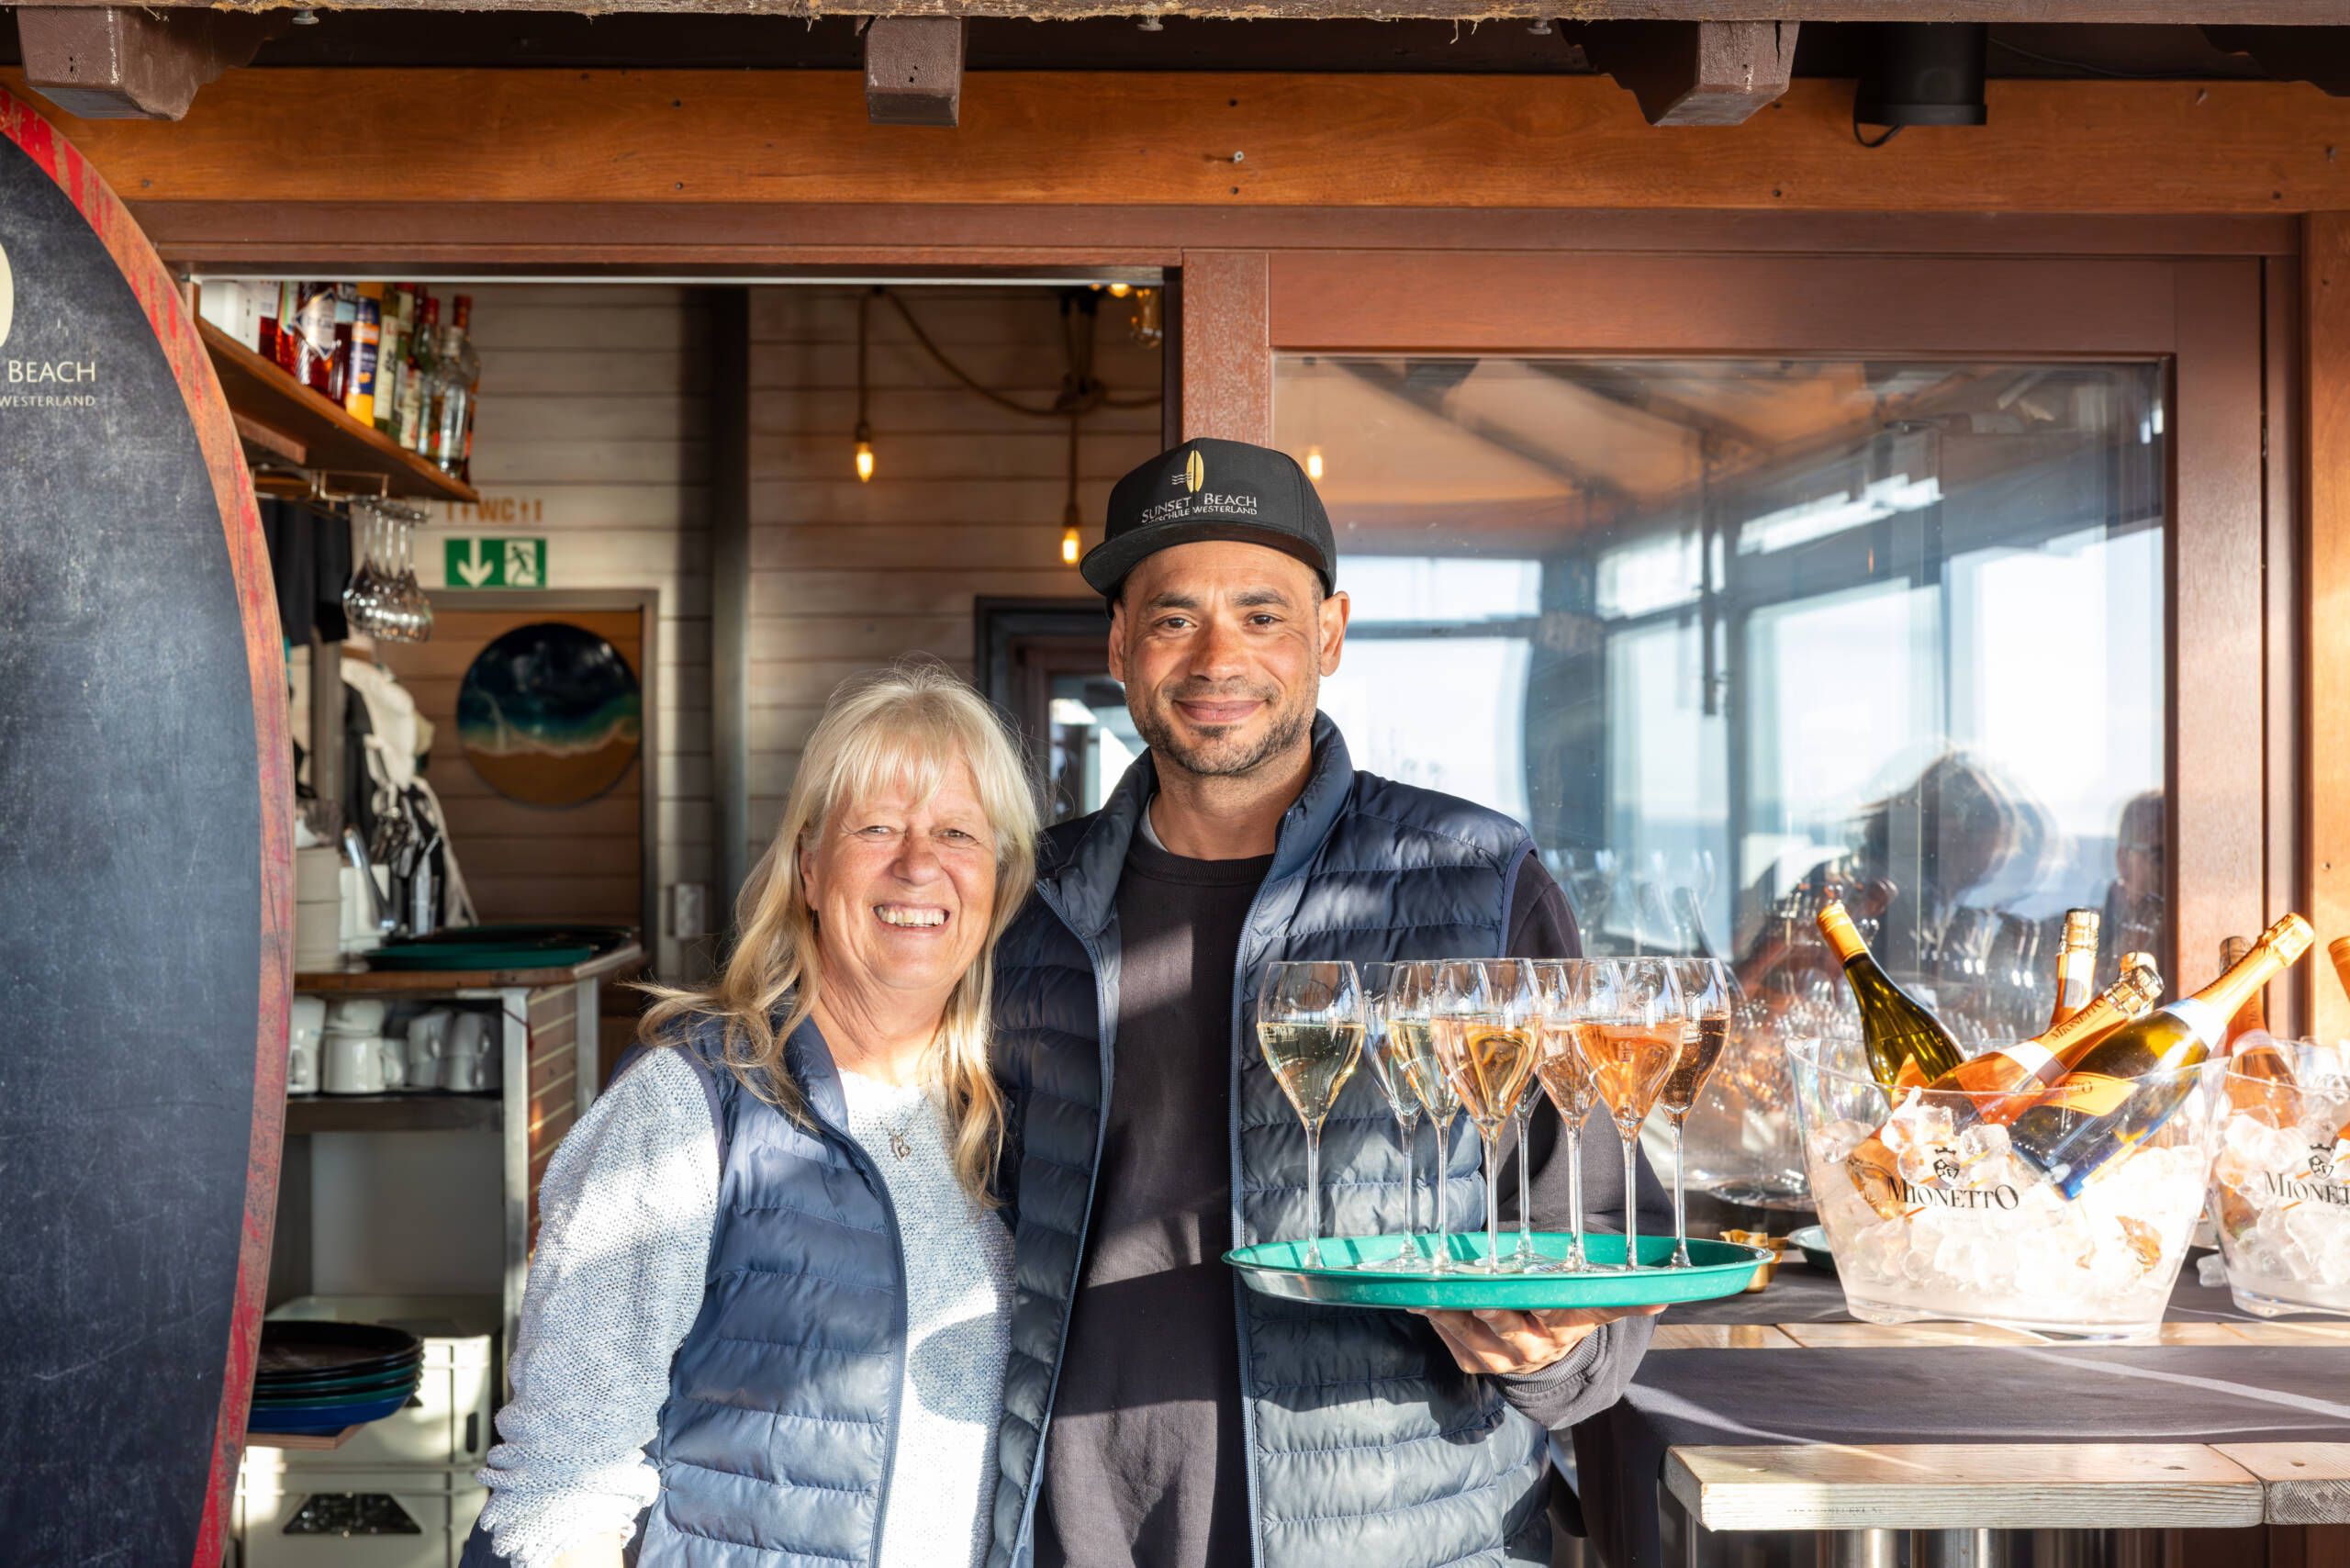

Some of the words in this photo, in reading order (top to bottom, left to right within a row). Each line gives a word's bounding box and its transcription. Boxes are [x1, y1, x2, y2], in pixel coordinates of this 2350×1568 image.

[8, 360, 95, 383] BEACH
[0, 395, 95, 407] WESTERLAND
[1141, 497, 1192, 523] SUNSET
[1204, 493, 1257, 507] BEACH
[1193, 506, 1258, 515] WESTERLAND
[1886, 1175, 2020, 1211] MIONETTO
